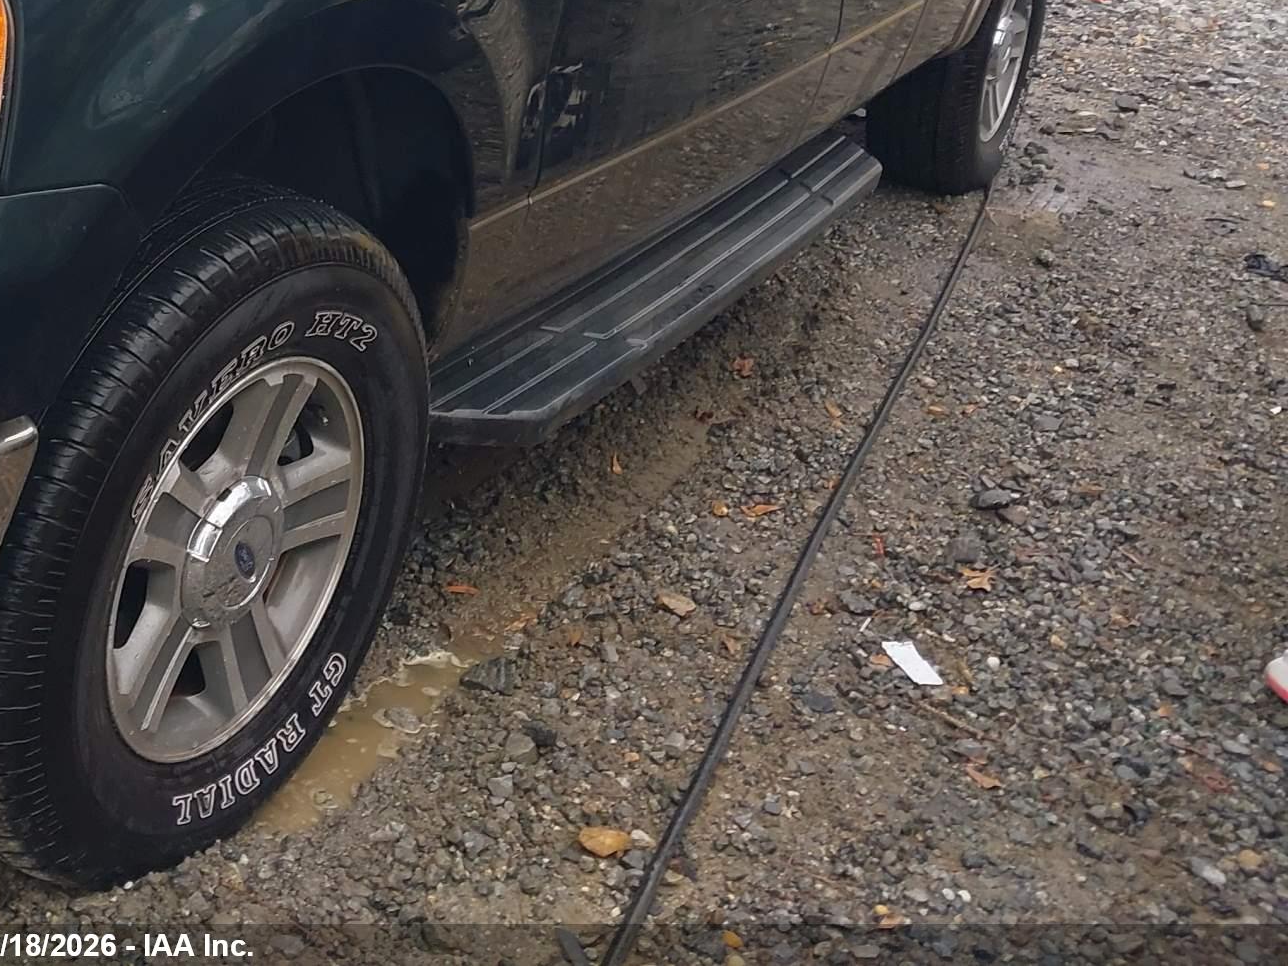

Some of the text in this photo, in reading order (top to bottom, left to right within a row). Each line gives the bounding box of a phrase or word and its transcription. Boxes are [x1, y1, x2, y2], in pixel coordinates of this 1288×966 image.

[305, 311, 378, 353] HT2
[172, 652, 347, 826] GT RADIAL
